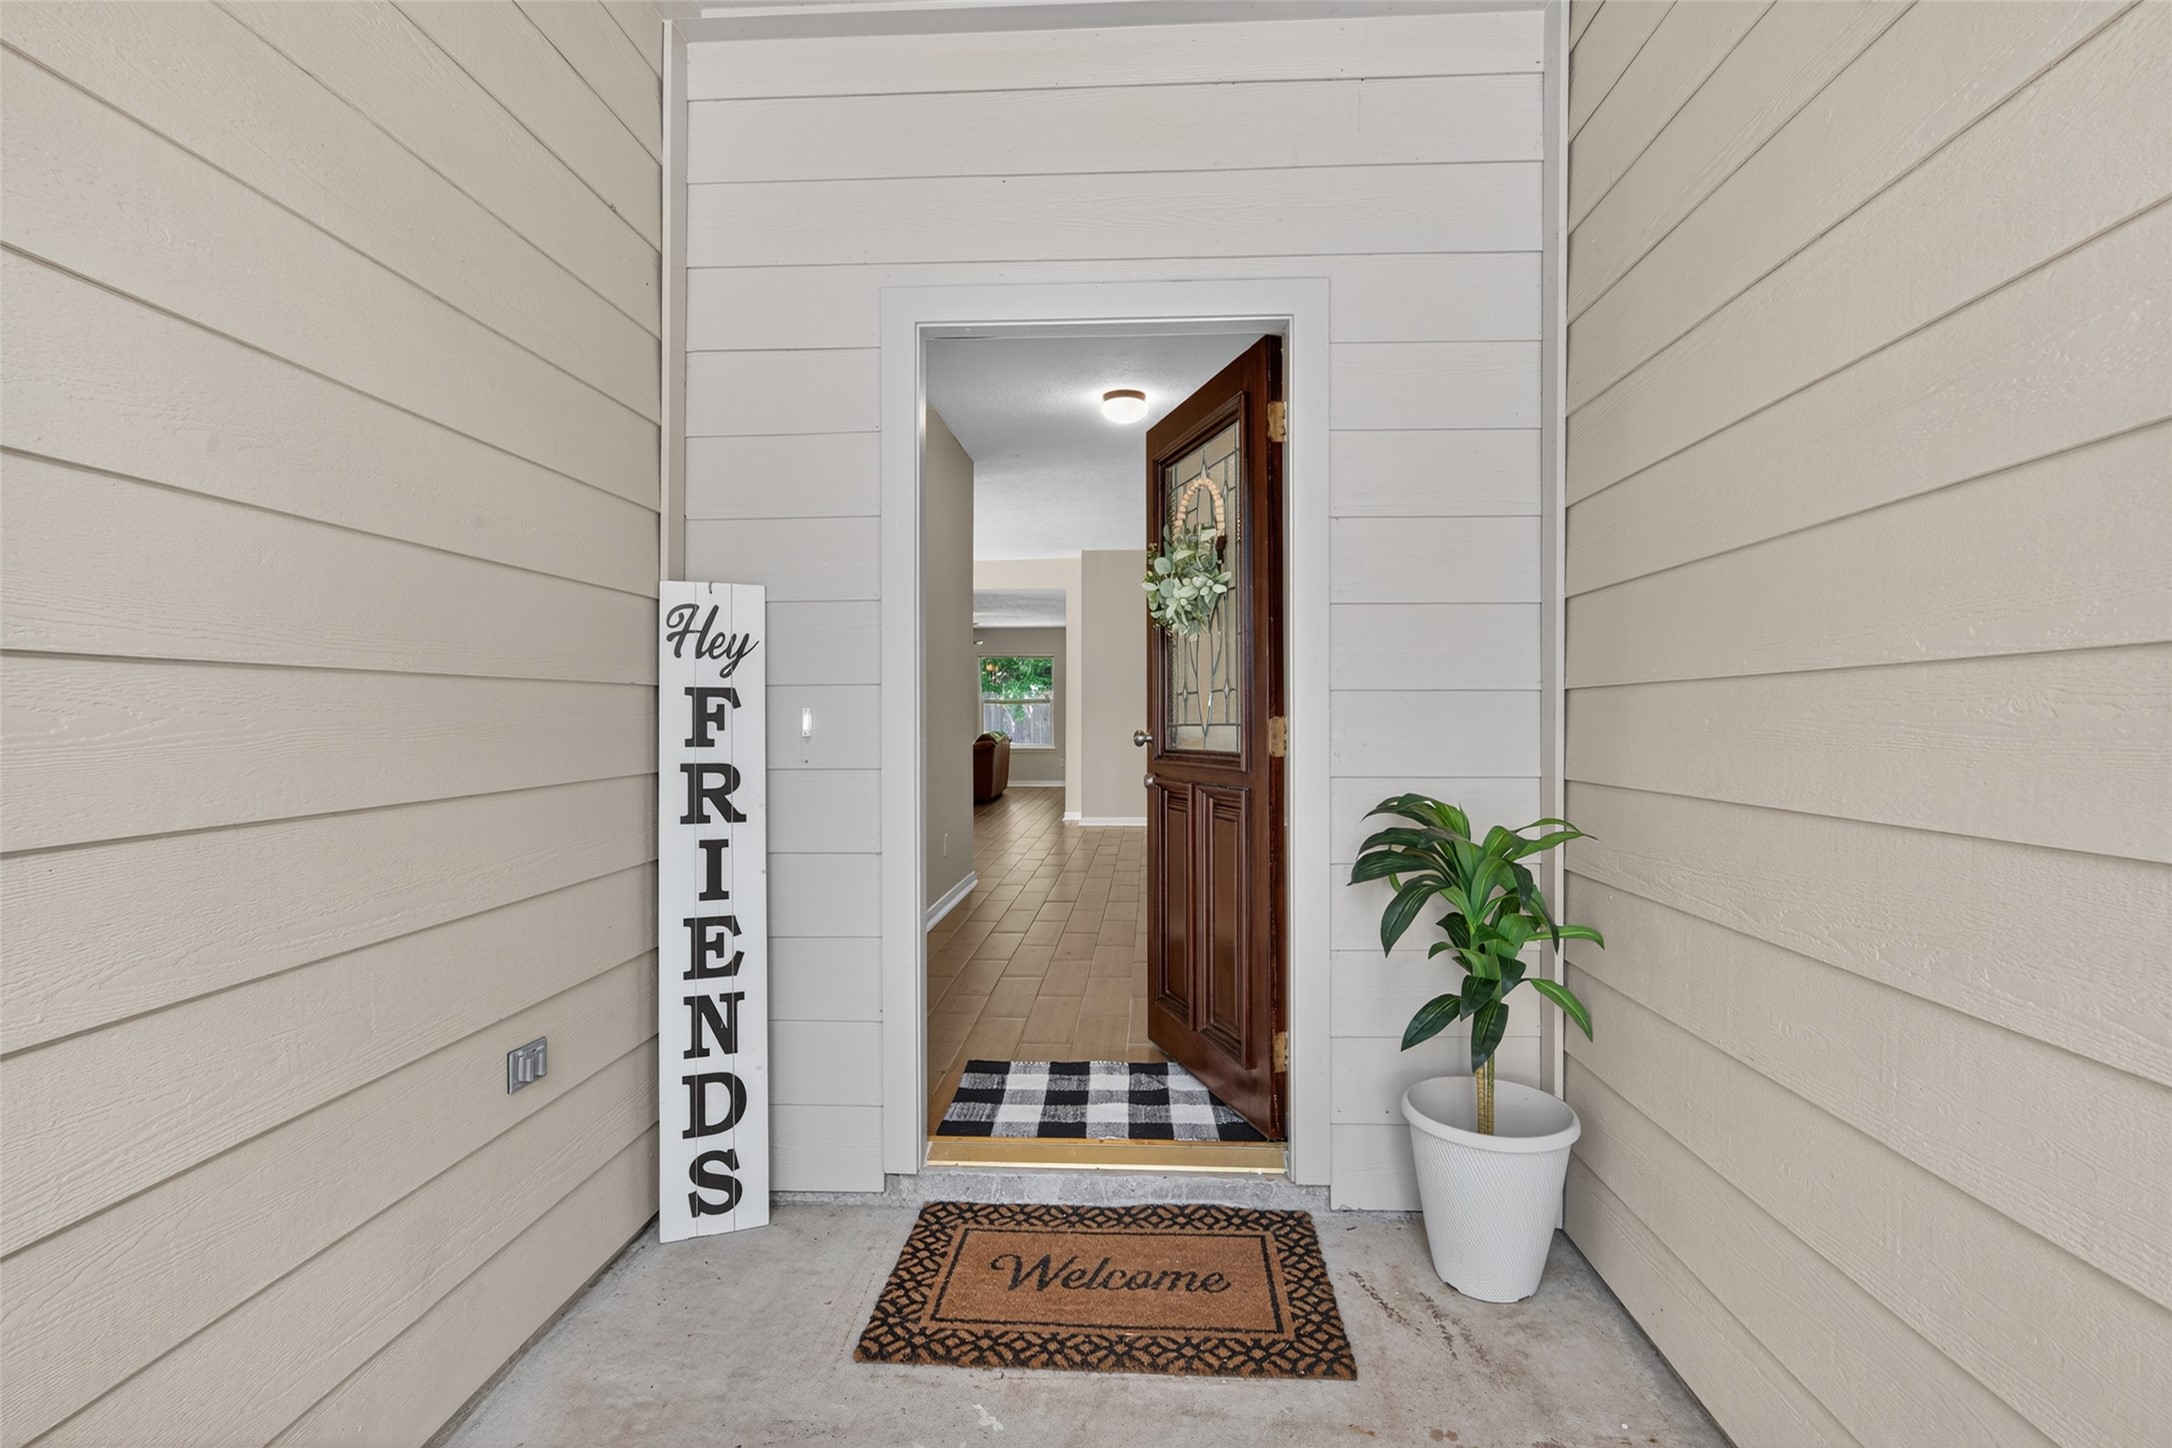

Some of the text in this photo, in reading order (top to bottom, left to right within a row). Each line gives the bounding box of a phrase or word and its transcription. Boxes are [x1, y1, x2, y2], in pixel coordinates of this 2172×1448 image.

[666, 603, 760, 679] Hey
[680, 687, 748, 1218] FRIENDS
[990, 1253, 1231, 1294] Welcome
